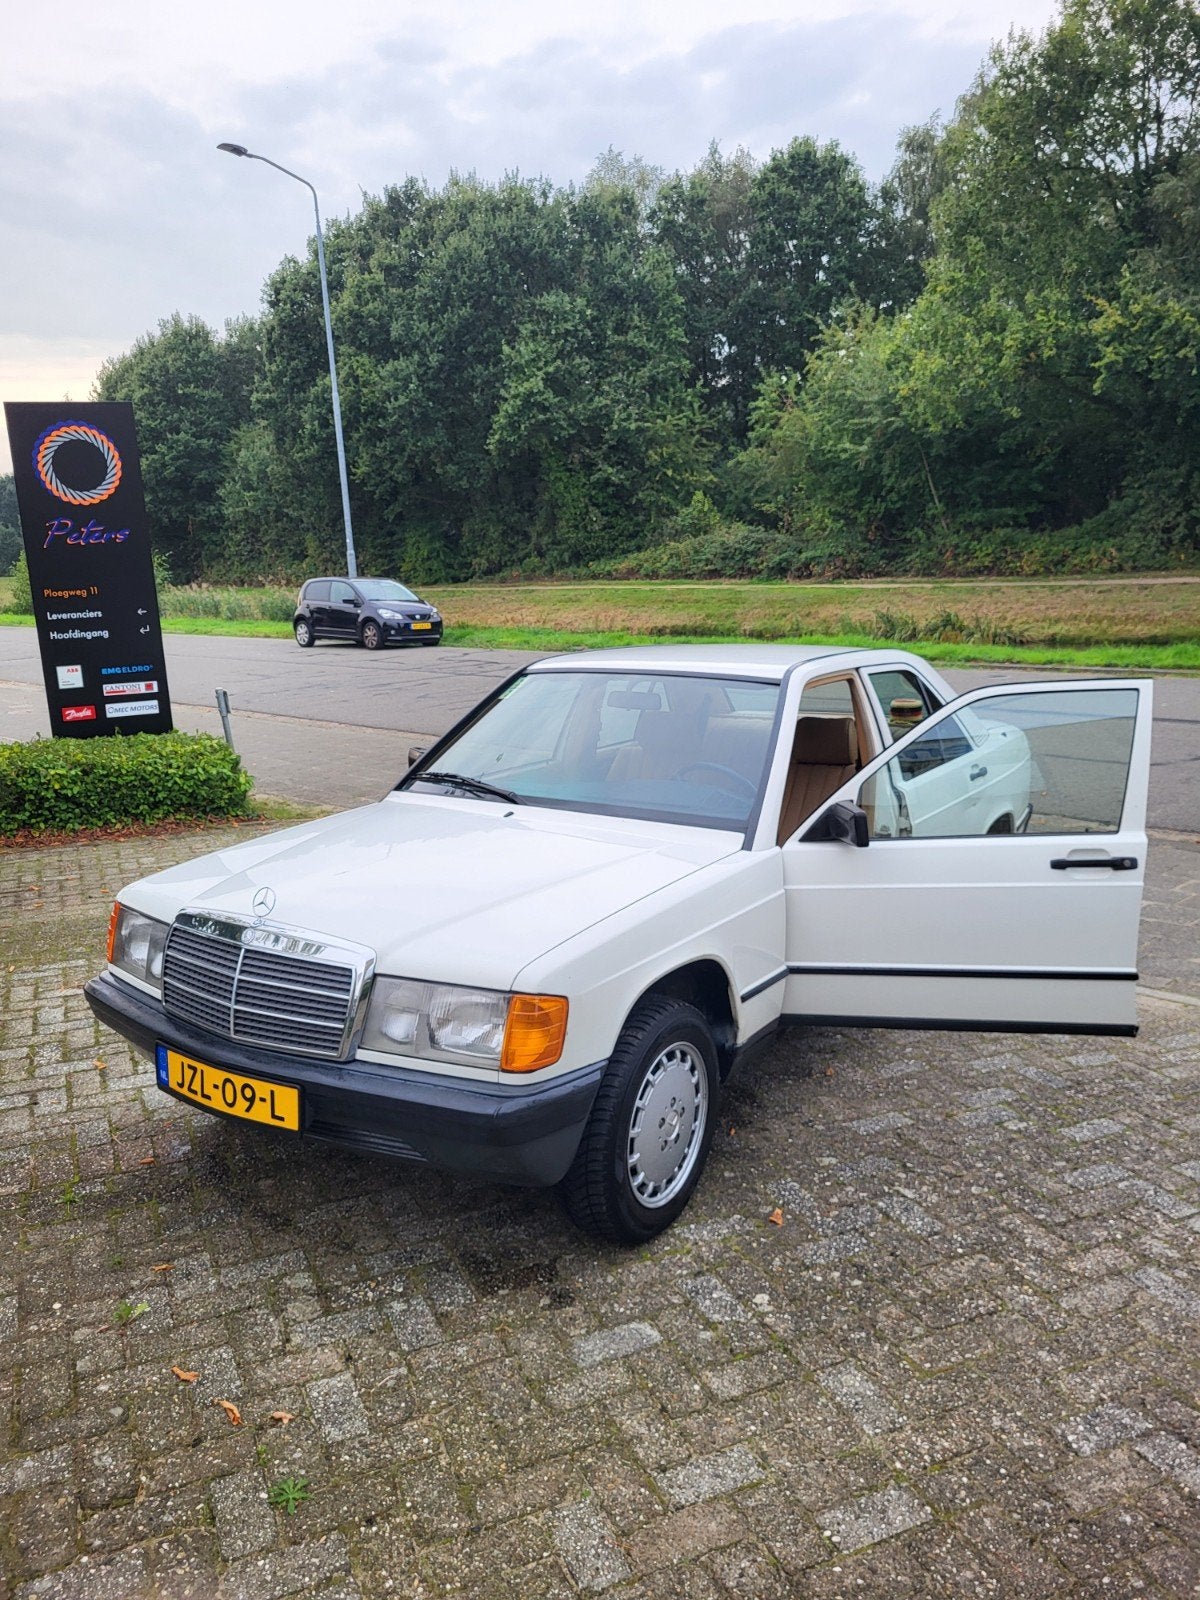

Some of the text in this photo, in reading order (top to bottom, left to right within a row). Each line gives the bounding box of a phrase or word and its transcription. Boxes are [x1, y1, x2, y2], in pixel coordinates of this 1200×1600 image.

[43, 517, 131, 549] Peters
[43, 586, 98, 599] Ploegweg 11
[46, 609, 103, 621] Leveranciers
[49, 629, 109, 640] Hoofdingang
[176, 1060, 285, 1122] JZL-09-L
